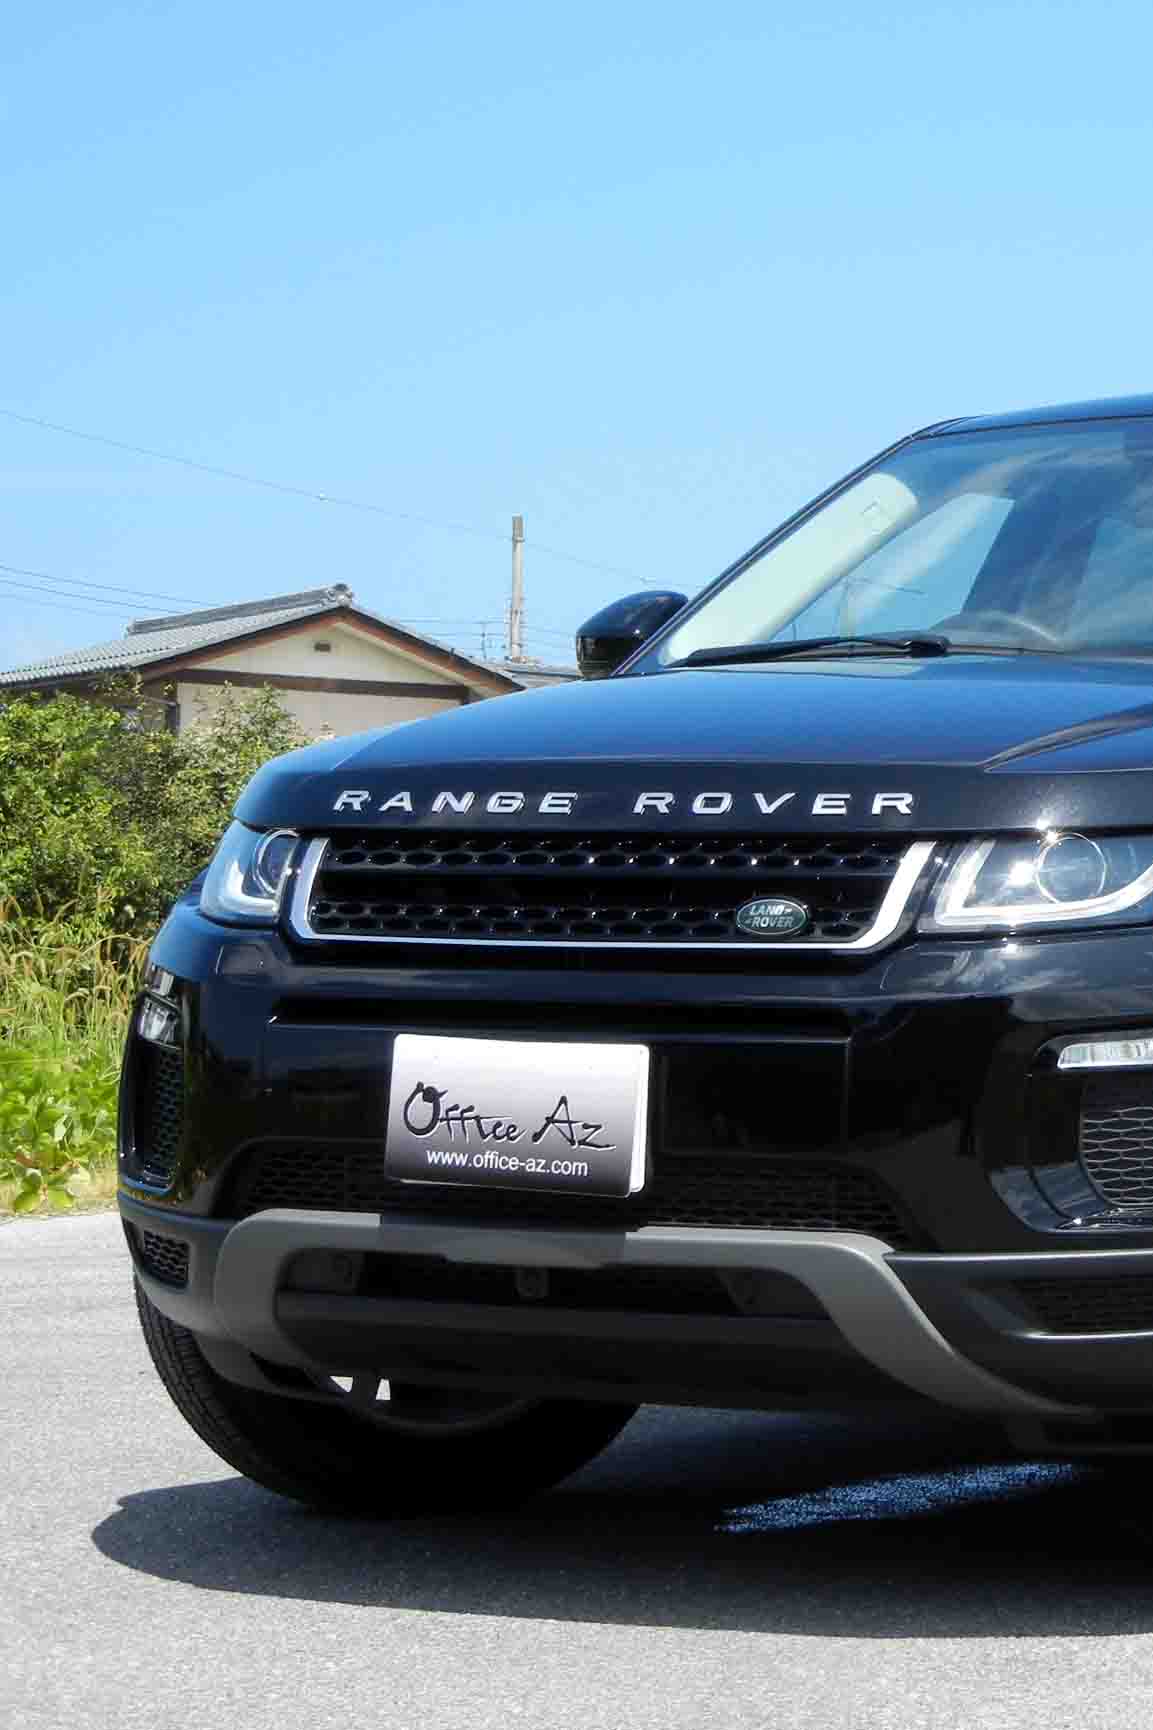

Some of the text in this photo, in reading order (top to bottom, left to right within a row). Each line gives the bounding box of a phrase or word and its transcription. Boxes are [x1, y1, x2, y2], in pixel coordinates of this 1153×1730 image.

[332, 789, 914, 816] RANGE ROVER
[403, 1081, 617, 1150] Office Az
[426, 1150, 588, 1177] www.office-az.com
